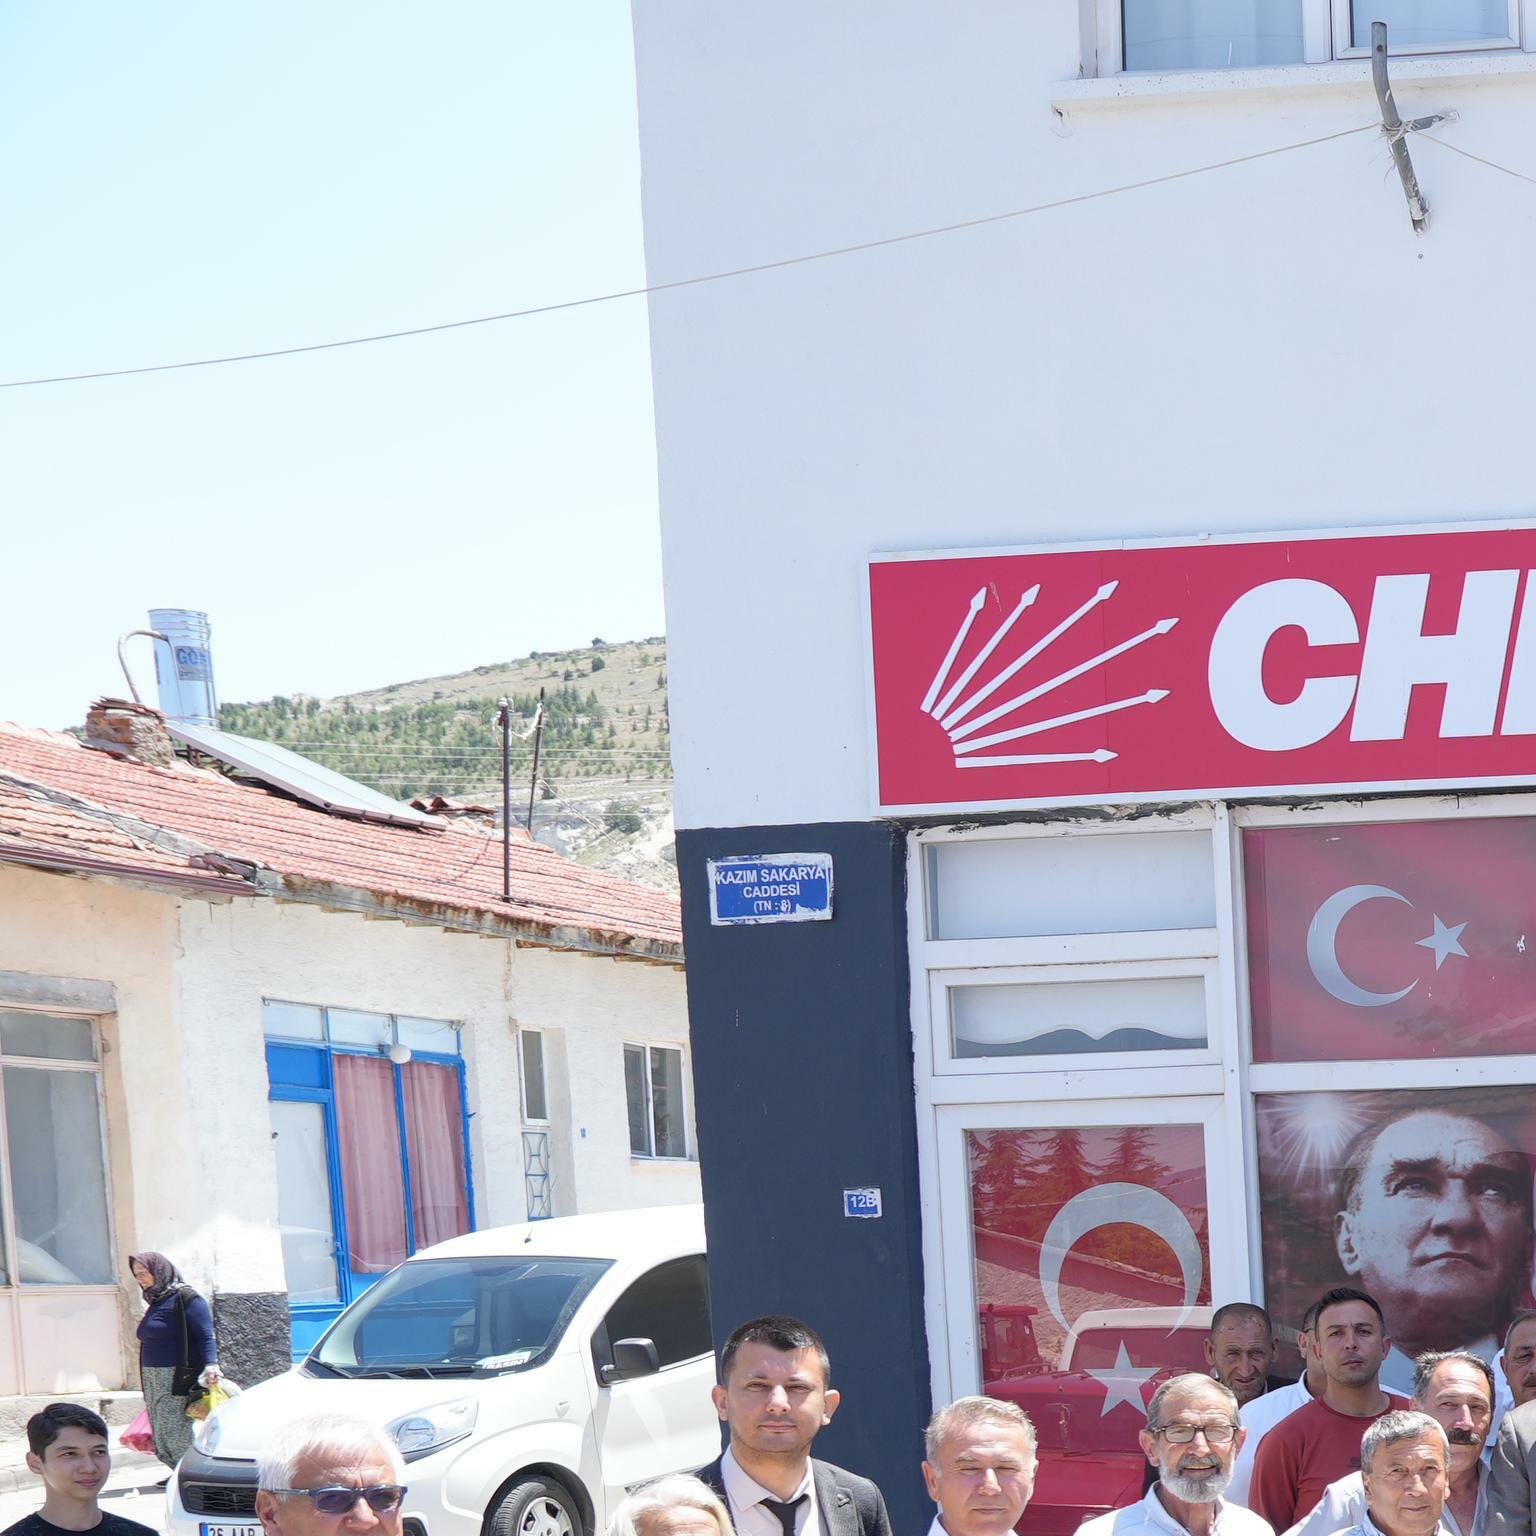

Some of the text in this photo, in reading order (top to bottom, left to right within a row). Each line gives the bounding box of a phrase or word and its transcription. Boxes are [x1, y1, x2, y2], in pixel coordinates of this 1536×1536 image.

[717, 867, 825, 885] KAZIM SAKARYA
[743, 882, 800, 898] CADDESİ
[850, 1196, 876, 1207] 12B
